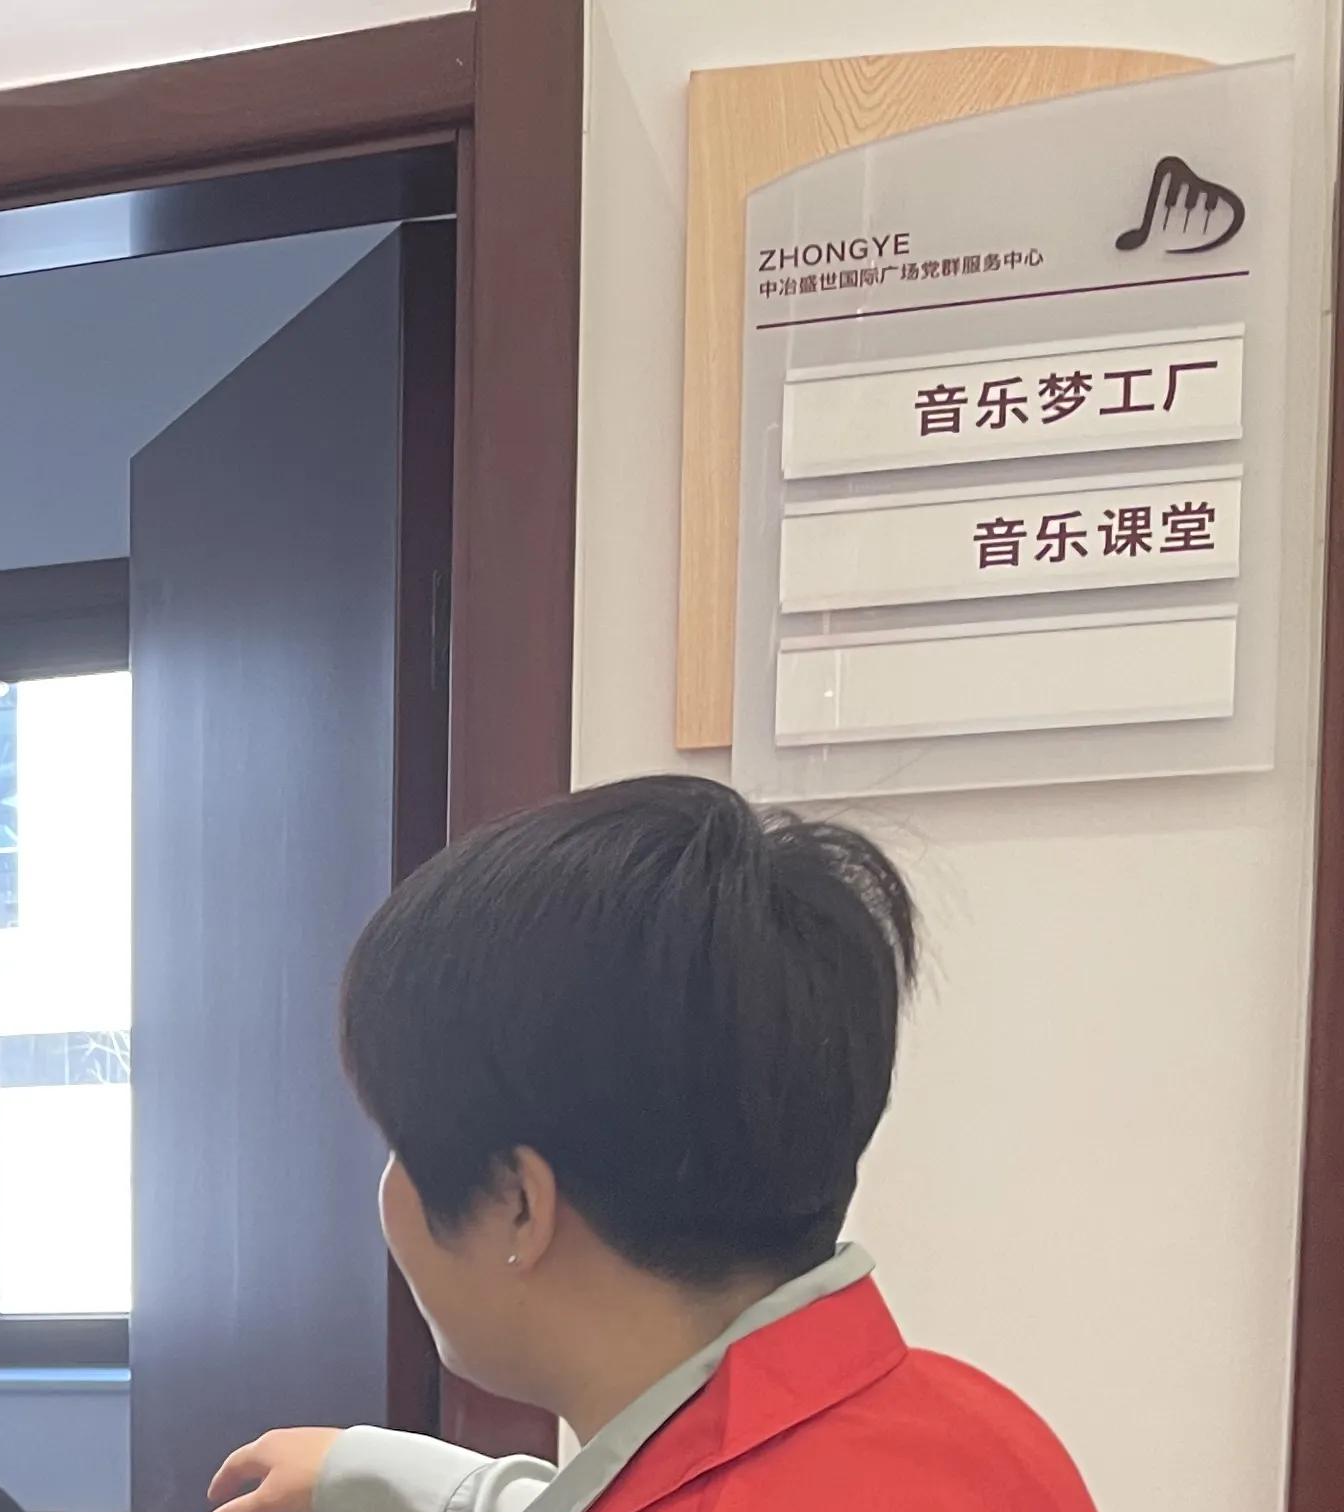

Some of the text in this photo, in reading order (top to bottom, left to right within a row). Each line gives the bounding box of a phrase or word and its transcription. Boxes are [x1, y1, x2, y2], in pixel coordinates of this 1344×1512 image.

[758, 232, 911, 272] ZHONGYE
[759, 248, 1044, 300] 中冶盛世国际广场党群服务中心
[914, 360, 1219, 437] 音乐梦工厂
[972, 501, 1217, 570] 音乐课堂
